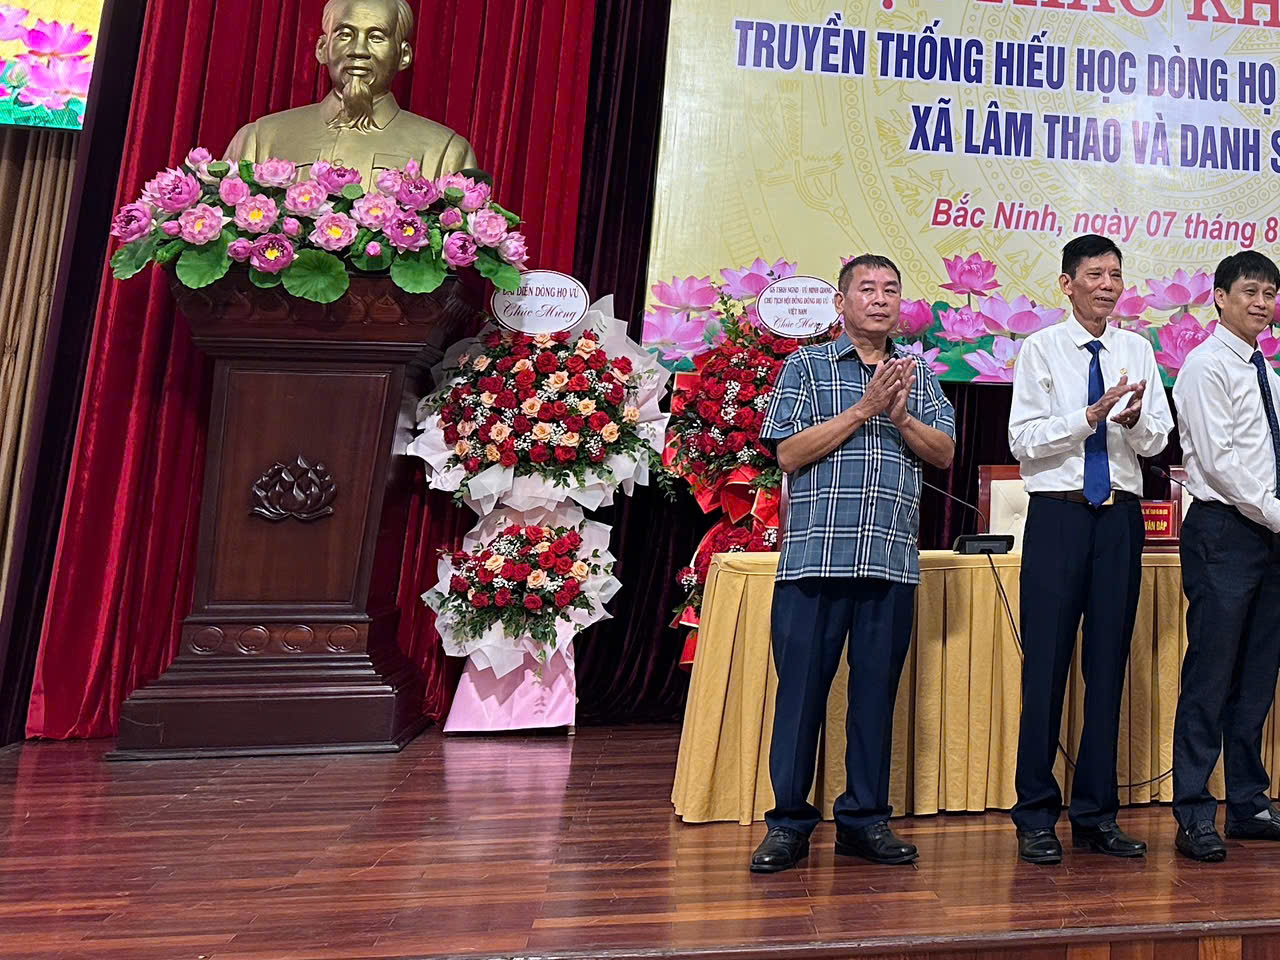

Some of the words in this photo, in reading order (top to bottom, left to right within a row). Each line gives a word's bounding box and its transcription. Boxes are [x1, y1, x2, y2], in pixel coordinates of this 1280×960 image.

[735, 13, 866, 75] TRUYỀN
[877, 19, 984, 84] THỐNG
[994, 30, 1065, 90] HIẾU
[1076, 48, 1137, 104] HỌC
[1147, 45, 1228, 102] DÒNG
[1238, 62, 1276, 115] HỌ
[909, 98, 953, 153] XÃ
[964, 101, 1032, 157] LÂM
[1043, 114, 1121, 163] THAO
[1132, 114, 1171, 166] VÀ
[1180, 123, 1261, 172] DANH
[931, 193, 985, 229] Bắc
[993, 202, 1063, 236] Ninh,
[1072, 209, 1138, 242] ngày
[1146, 210, 1178, 237] 07
[1184, 213, 1257, 248] tháng
[1264, 217, 1279, 243] 8
